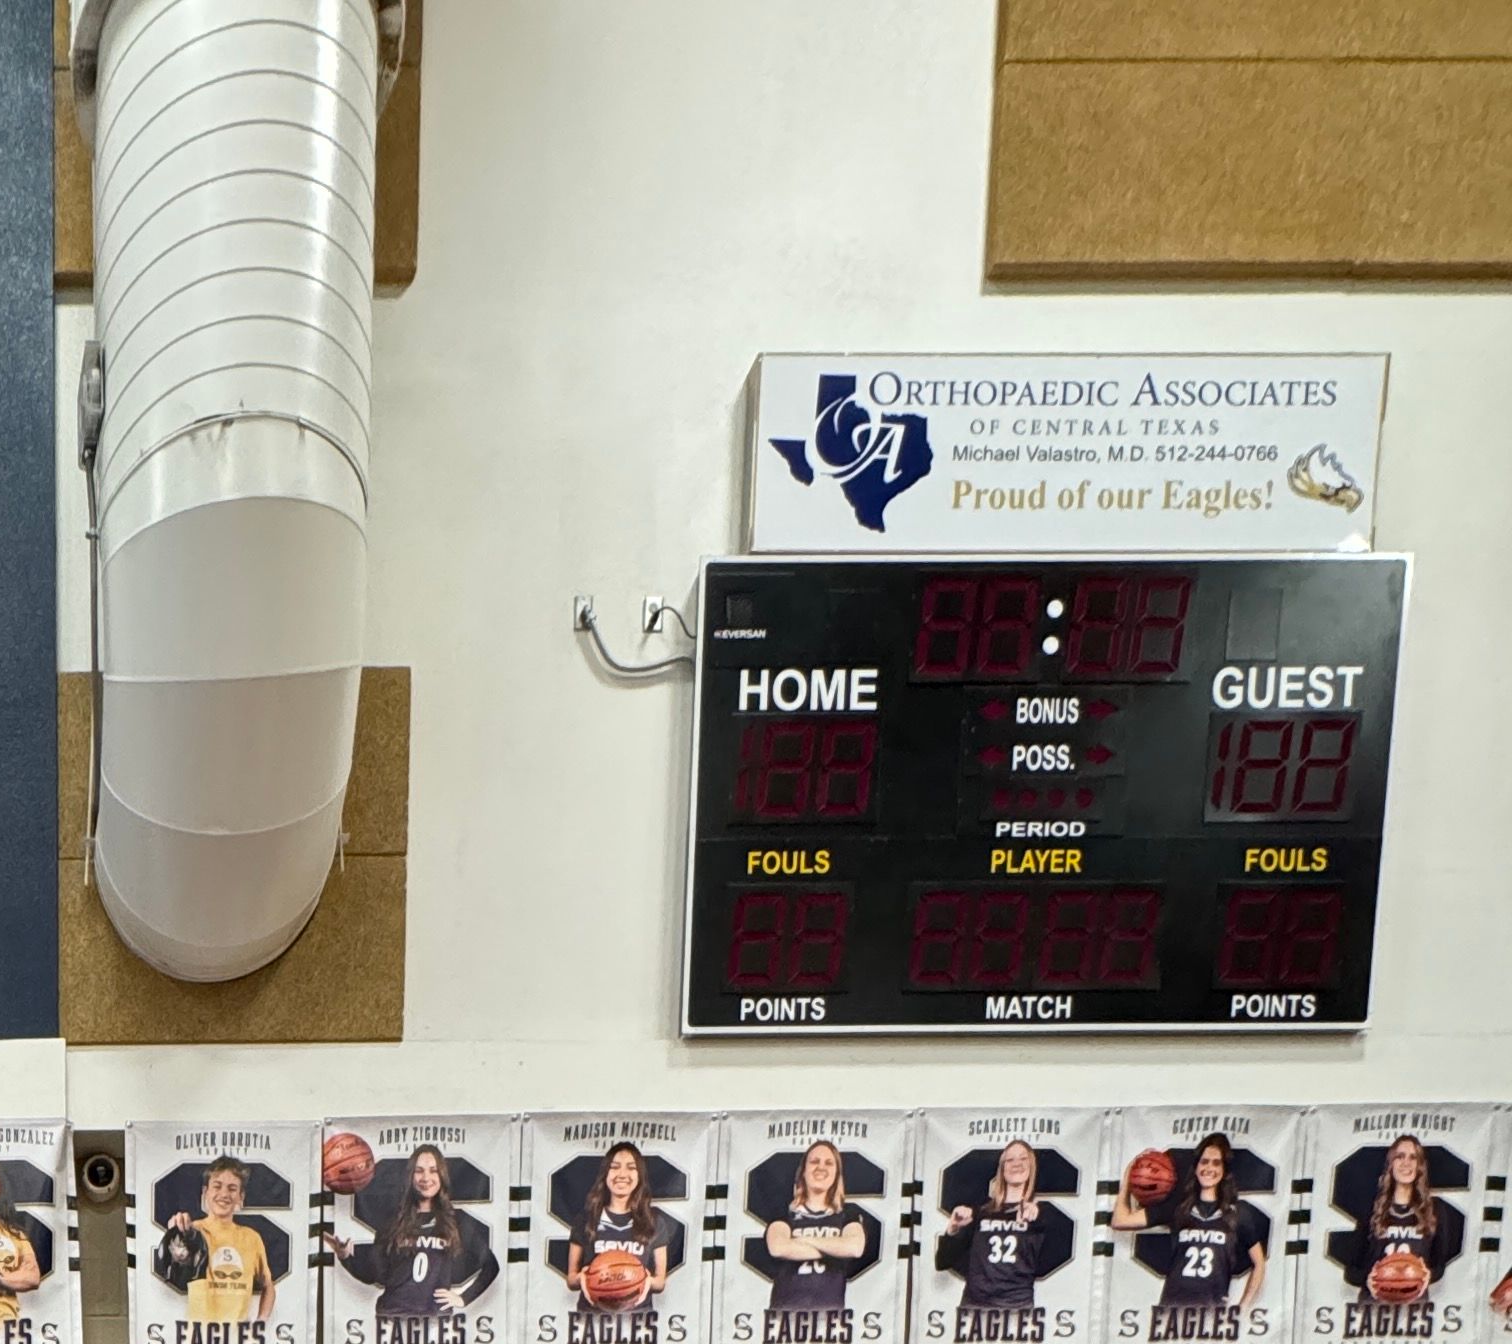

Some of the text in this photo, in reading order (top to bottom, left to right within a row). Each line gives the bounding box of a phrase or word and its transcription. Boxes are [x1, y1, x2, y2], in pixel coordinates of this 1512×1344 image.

[869, 371, 1338, 407] ORTHOPAEDIC ASSOCIATES
[970, 418, 1221, 436] OF CENTRAL TEXAS
[953, 445, 1279, 465] Michael Valastro, M.D. 512-244-0766
[952, 478, 1275, 519] Proud of our Eagles!
[738, 668, 879, 712] HOME
[1212, 666, 1363, 709] GUEST
[1016, 696, 1080, 725] BONUS
[1011, 744, 1076, 771] POSS.
[995, 821, 1086, 838] PERIOD
[747, 850, 831, 875] FOULS
[990, 848, 1083, 874] PLAYER
[1244, 848, 1328, 873] FOULS
[740, 997, 826, 1022] POINTS
[985, 996, 1074, 1021] MATCH
[1230, 994, 1317, 1019] POINTS
[379, 1126, 466, 1145] ABBY ZIGROSSI
[563, 1121, 676, 1142] MADISON MITCHELL
[831, 1120, 868, 1138] MEYER
[968, 1117, 1060, 1136] SCARLETT LONG
[175, 1131, 216, 1150] OLIVER
[988, 1234, 1017, 1264] 32
[1181, 1246, 1214, 1278] 23
[953, 1307, 1046, 1344] EAGLES
[1148, 1305, 1241, 1342] EAGLES
[1342, 1302, 1435, 1340] EAGLES
